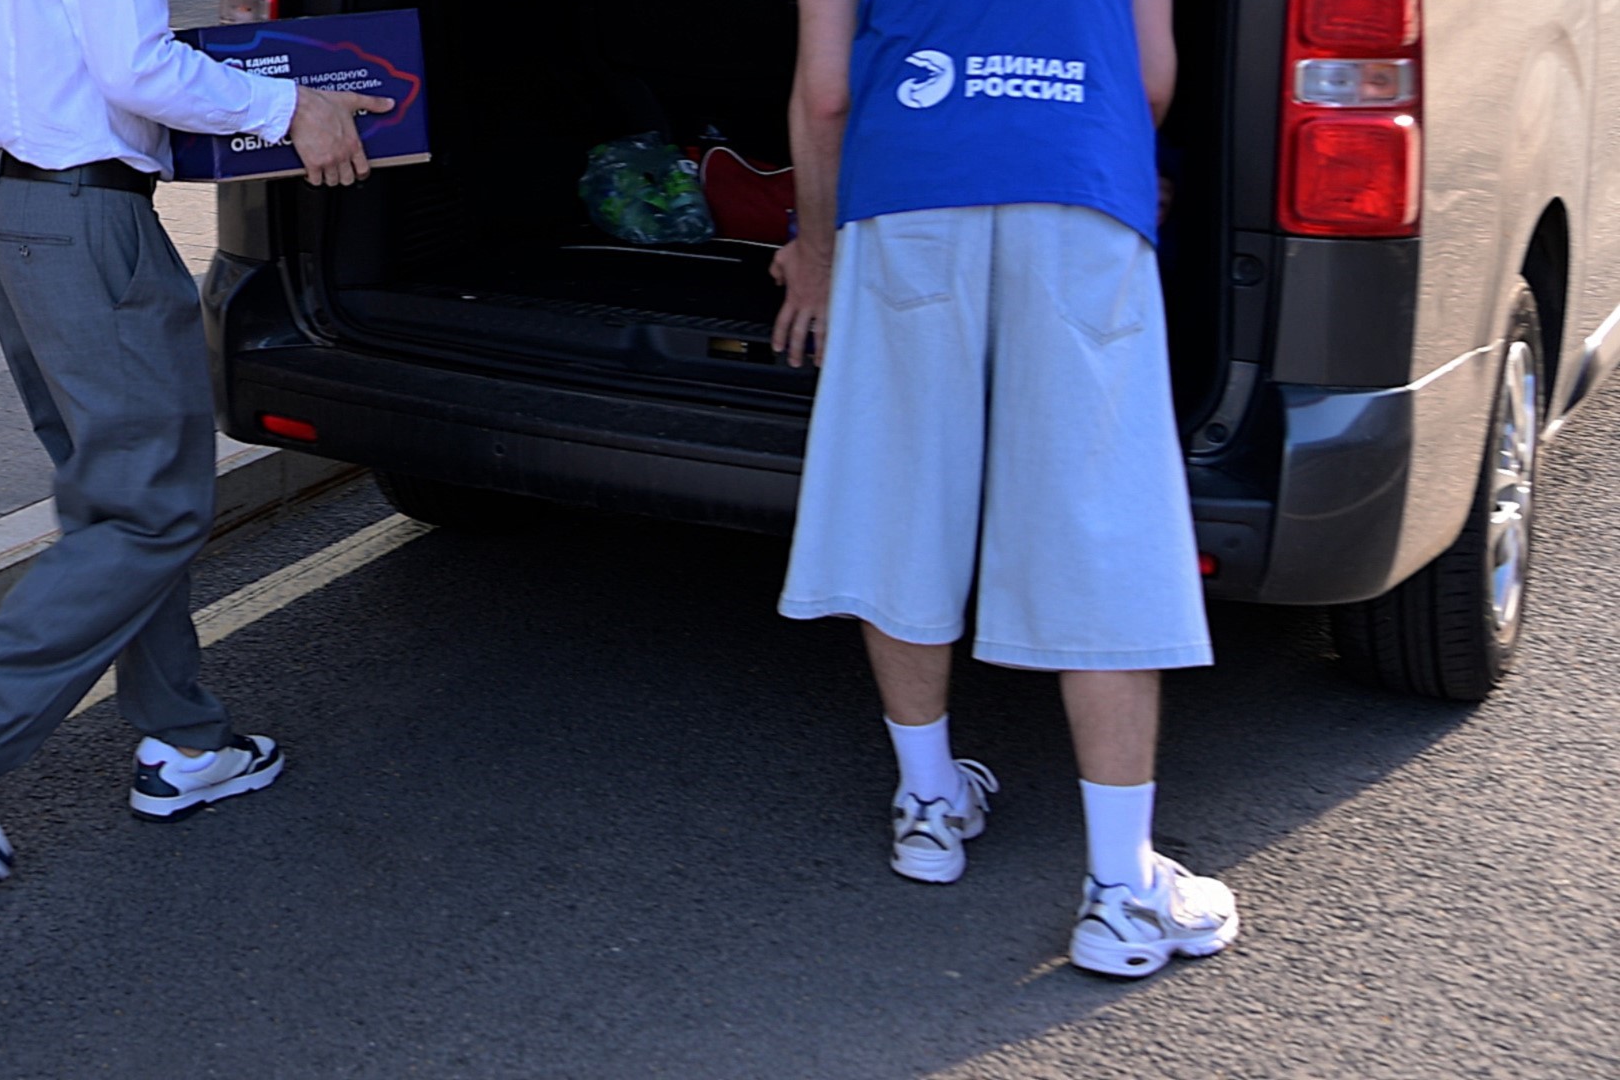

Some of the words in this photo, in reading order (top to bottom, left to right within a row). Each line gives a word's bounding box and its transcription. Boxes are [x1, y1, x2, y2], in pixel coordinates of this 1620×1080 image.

[246, 55, 289, 68] ЕДИНАЯ
[965, 55, 1086, 81] ЕДИНАЯ
[302, 76, 308, 85] В
[310, 69, 368, 84] НАРОДНУЮ
[336, 79, 382, 91] РОССИИ»
[964, 77, 1085, 104] РОССИЯ
